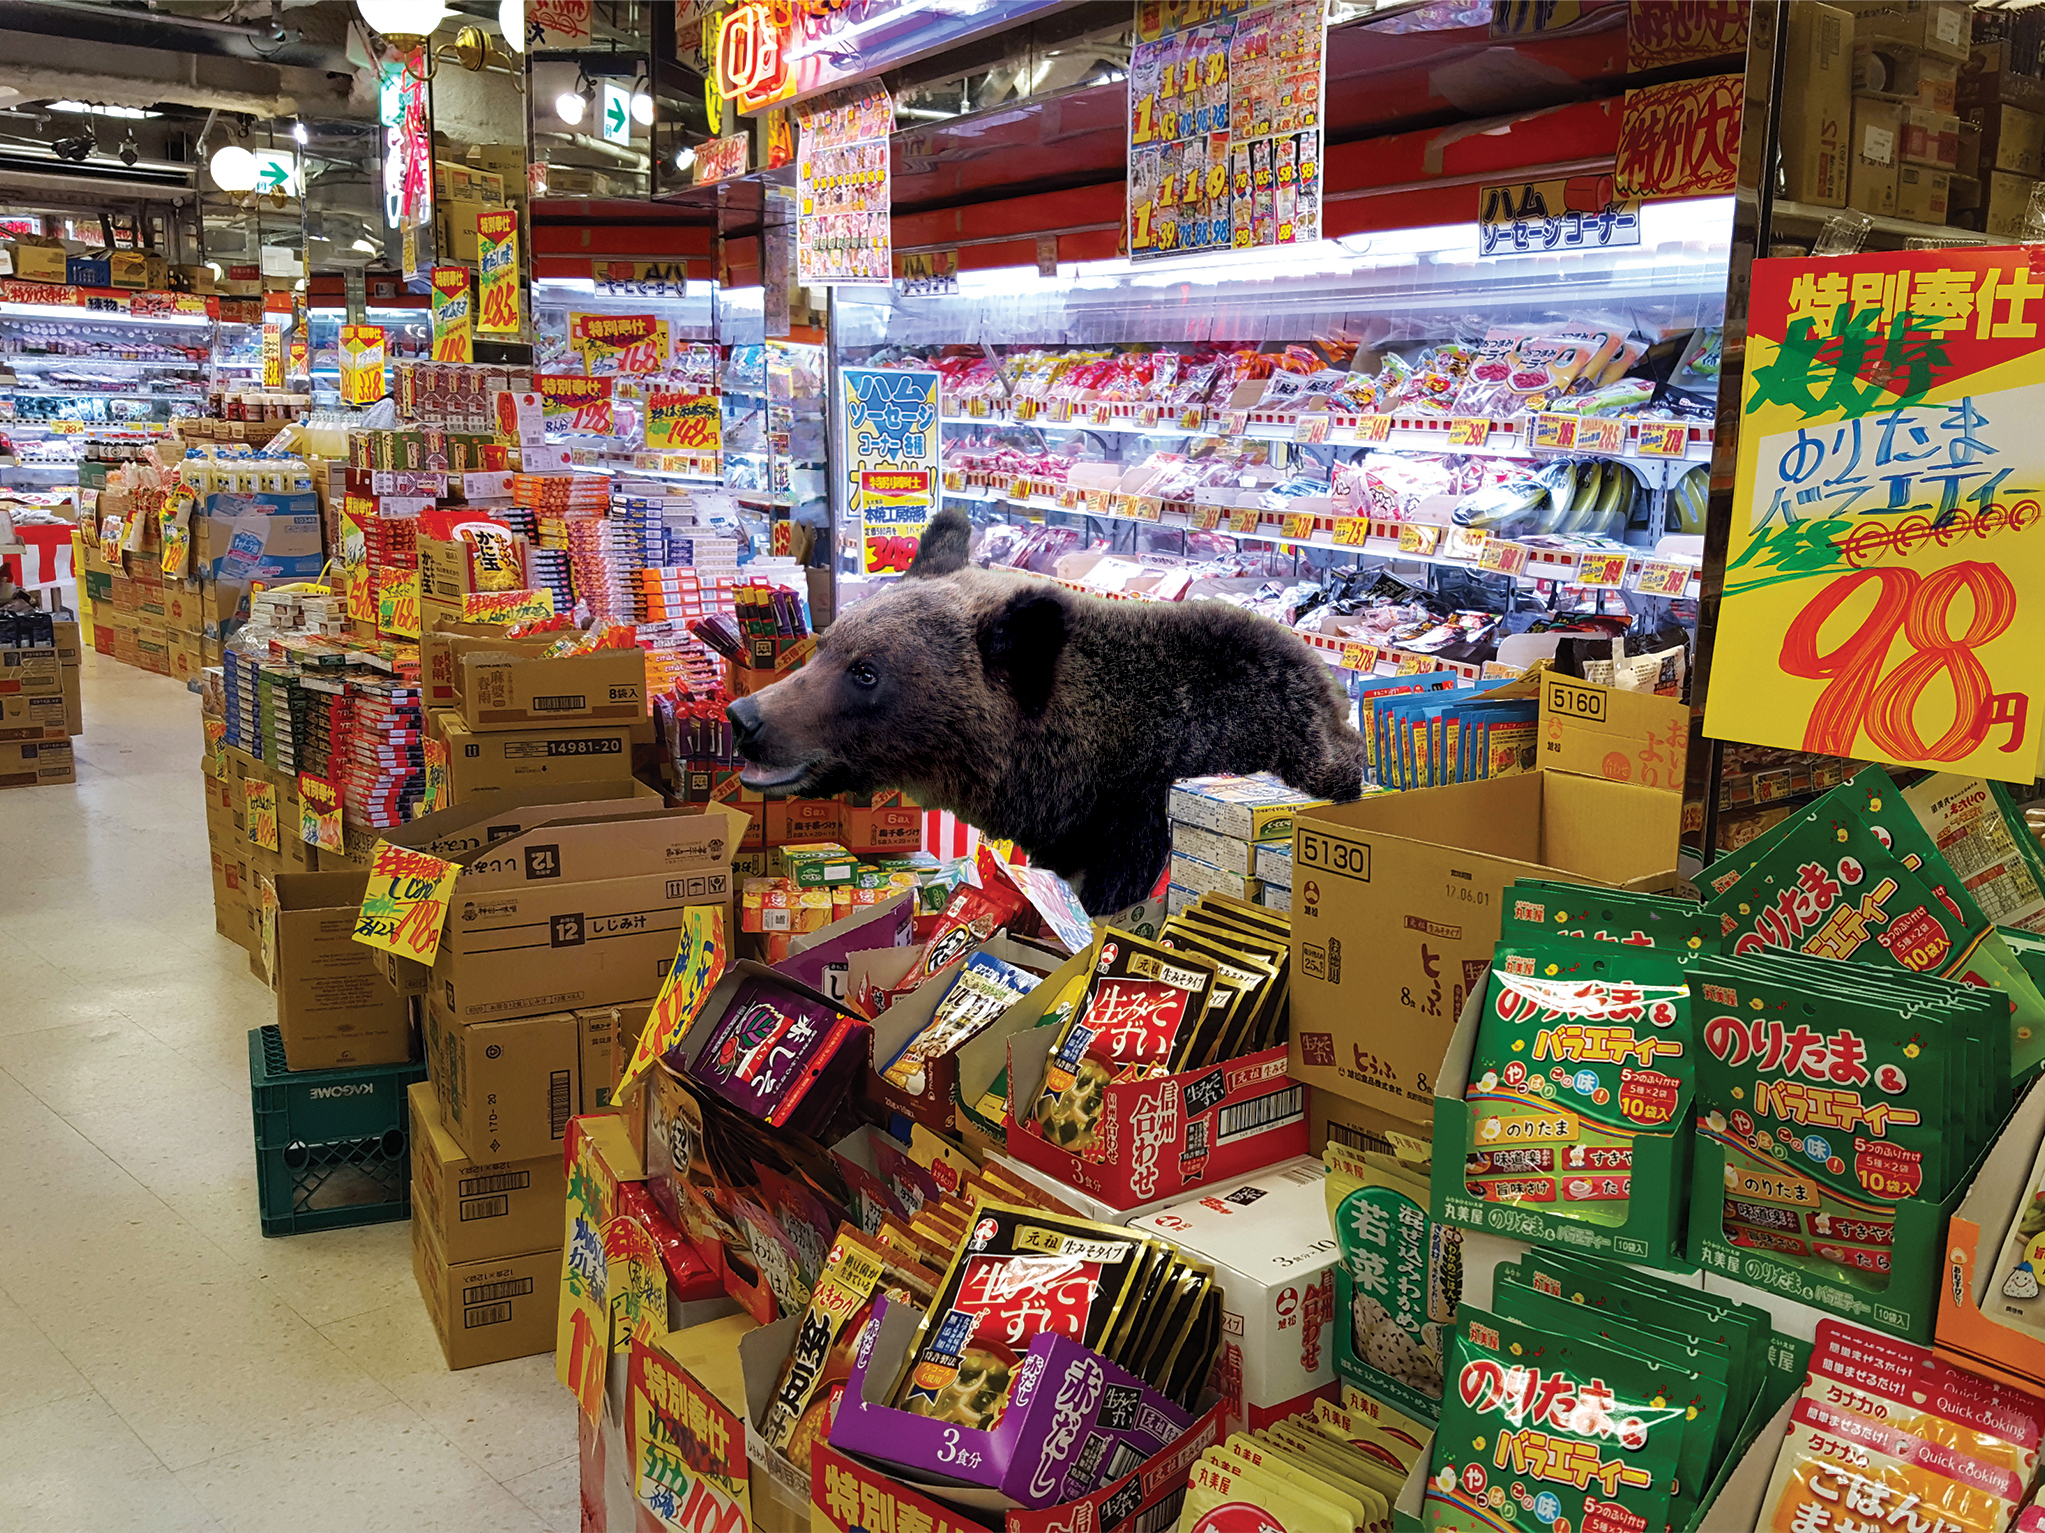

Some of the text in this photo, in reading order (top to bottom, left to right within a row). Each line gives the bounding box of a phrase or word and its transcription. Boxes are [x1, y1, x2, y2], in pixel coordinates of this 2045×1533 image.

[1483, 184, 1548, 222] ハム
[1482, 205, 1636, 253] ソーセージコーナー
[1787, 268, 2044, 341] 特別奉仕
[588, 319, 646, 336] 特別奉仕
[541, 377, 601, 395] 特別奉仕
[857, 375, 927, 402] ハム
[849, 402, 935, 432] ソーセージ
[1778, 395, 1999, 484] のりたま
[869, 476, 922, 489] 特別奉仕
[1749, 461, 2041, 536] バラエティー
[475, 531, 504, 571] かに玉
[609, 688, 639, 699] 8袋入
[1554, 688, 1600, 715] 5160
[550, 739, 620, 755] 14981-20
[531, 851, 556, 870] 12
[1304, 839, 1365, 874] 5130
[1446, 884, 1489, 906] 17.06.01
[556, 916, 647, 941] 12 しじみ汁
[1514, 905, 1545, 923] 丸美屋
[1876, 904, 1928, 949] 5つのふりかけ
[1505, 960, 1535, 976] 丸美屋
[1903, 934, 1952, 974] 10袋入
[1138, 960, 1204, 989] 元祖 生みそタイプ
[1089, 985, 1178, 1027] 生みそ
[1704, 987, 1738, 1007] 丸美屋
[1111, 1020, 1169, 1057] ずい
[1533, 1025, 1683, 1066] バラエティー
[1237, 1068, 1259, 1086] 元祖
[1353, 1042, 1397, 1080] とうふ
[1619, 1067, 1681, 1089] 5つのふりかけ
[310, 1082, 374, 1099] KAGOME
[1186, 1073, 1221, 1100] 生みそ
[1159, 1080, 1179, 1144] 信州
[1620, 1098, 1672, 1123] 10袋入
[1755, 1080, 1922, 1136] バラエティー
[1507, 1119, 1570, 1137] のりたま
[1130, 1094, 1159, 1198] 合わせ
[1494, 1151, 1541, 1167] 味道楽
[1853, 1137, 1922, 1163] 5つのふりかけ
[1070, 1159, 1102, 1193] 3食分
[1332, 1156, 1365, 1181] 丸美屋
[1858, 1169, 1918, 1196] 10袋入
[1744, 1177, 1809, 1202] のりたま
[1025, 1231, 1127, 1261] 元祖 生みそタイプ
[1444, 1203, 1484, 1227] 丸美屋
[1617, 1239, 1646, 1256] 10袋入
[1351, 1198, 1390, 1296] 若菜
[1396, 1203, 1424, 1334] 混ぜ込みわかめ
[813, 1279, 855, 1319] ひきわり
[1701, 1247, 1740, 1274] 丸美屋
[1878, 1309, 1906, 1327] 10袋入
[1000, 1298, 1079, 1344] ずい
[1300, 1283, 1322, 1372] 合わせ
[1469, 1326, 1499, 1351] 丸美屋
[1018, 1354, 1044, 1407] 赤だし
[643, 1357, 731, 1467] 特別奉仕
[1103, 1387, 1138, 1412] 生みそ
[1350, 1392, 1379, 1420] 丸美屋
[1822, 1358, 2026, 1441] 簡単まぜるだけ! Quick cooking
[1826, 1384, 1889, 1419] タナカの
[1030, 1358, 1104, 1498] 赤だし
[1322, 1406, 1351, 1432] 丸美屋
[937, 1428, 982, 1470] 3食分
[1495, 1428, 1652, 1498] バラエティー
[1806, 1407, 2010, 1494] 簡単まぜるだけ! Quick cooking
[1808, 1434, 1871, 1469] タナカの
[1199, 1467, 1231, 1496] 丸美屋
[1583, 1496, 1647, 1530] 5つのふりかけ
